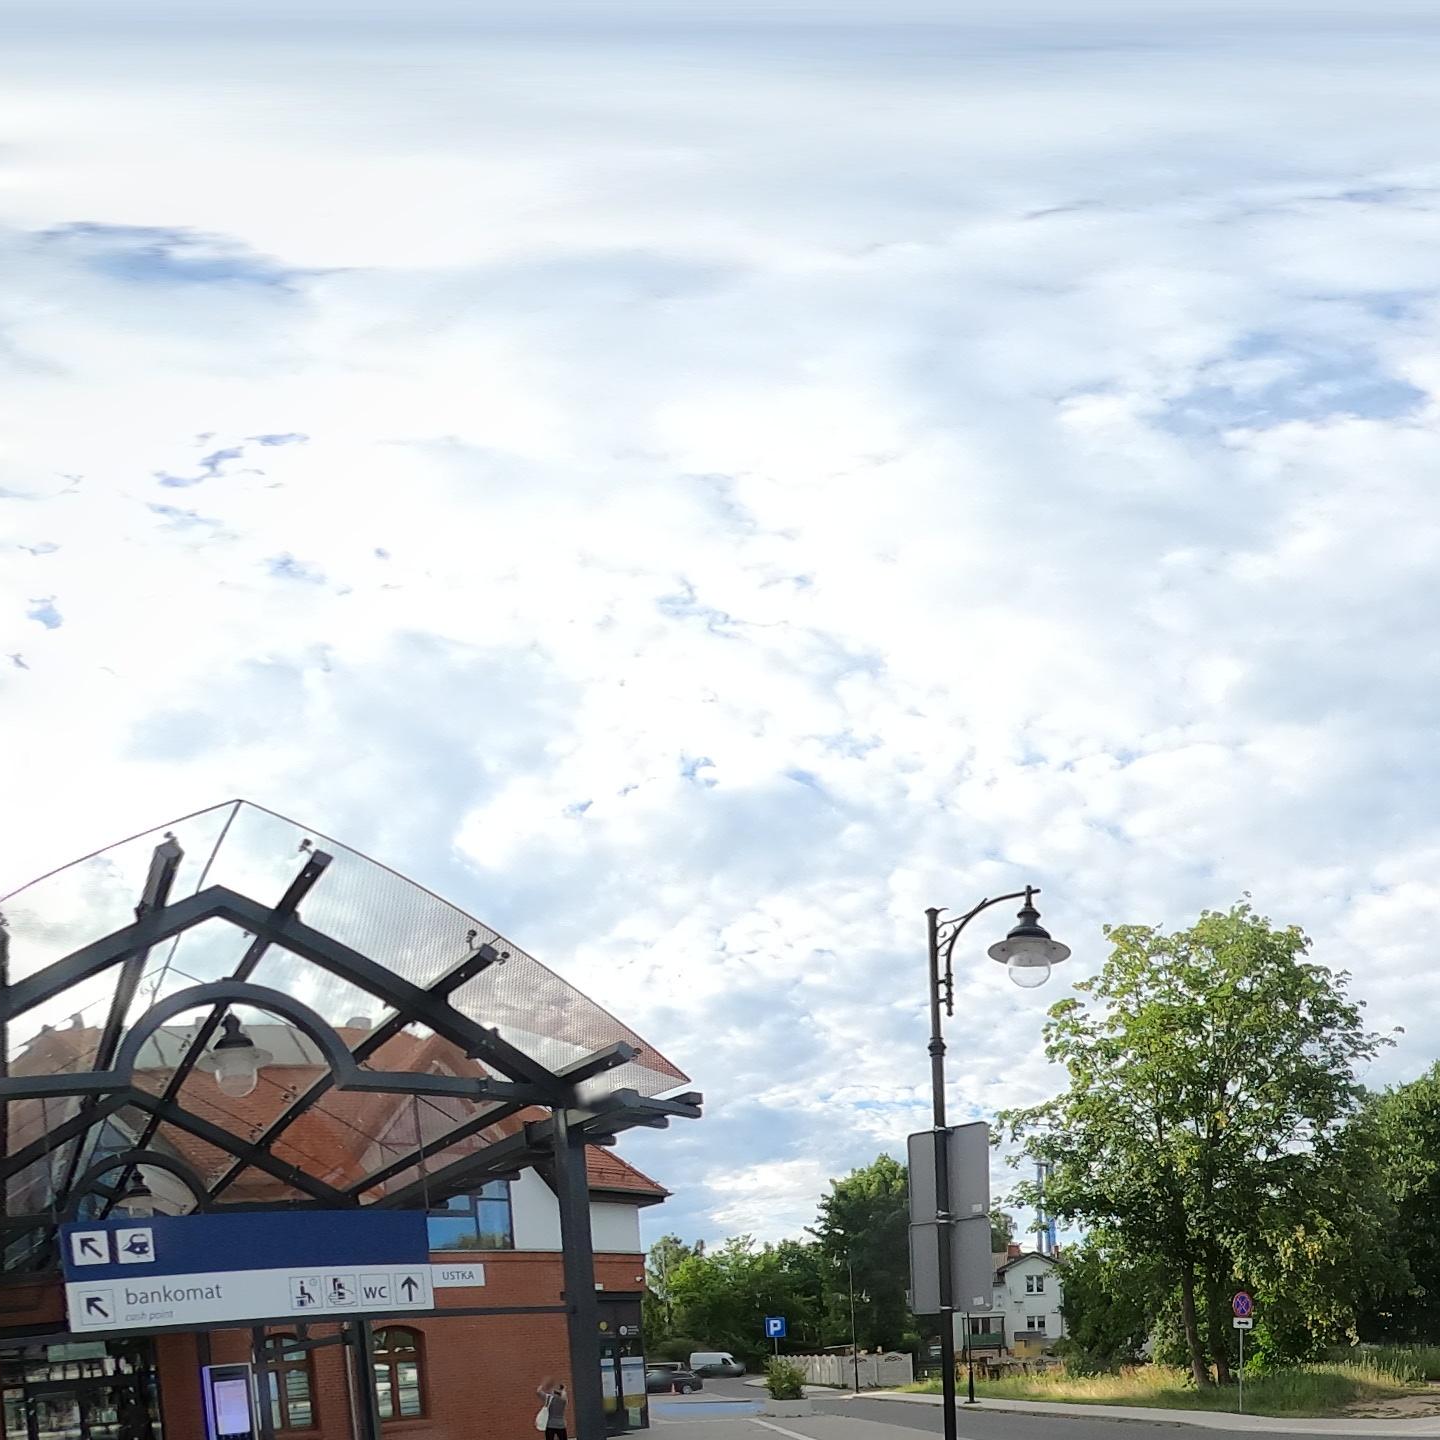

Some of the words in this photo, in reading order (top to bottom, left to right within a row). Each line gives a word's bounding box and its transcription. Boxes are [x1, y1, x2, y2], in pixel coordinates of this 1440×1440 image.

[442, 1270, 475, 1281] USTKA
[125, 1284, 223, 1305] bankomat
[363, 1286, 388, 1299] WC
[770, 1319, 782, 1336] P
